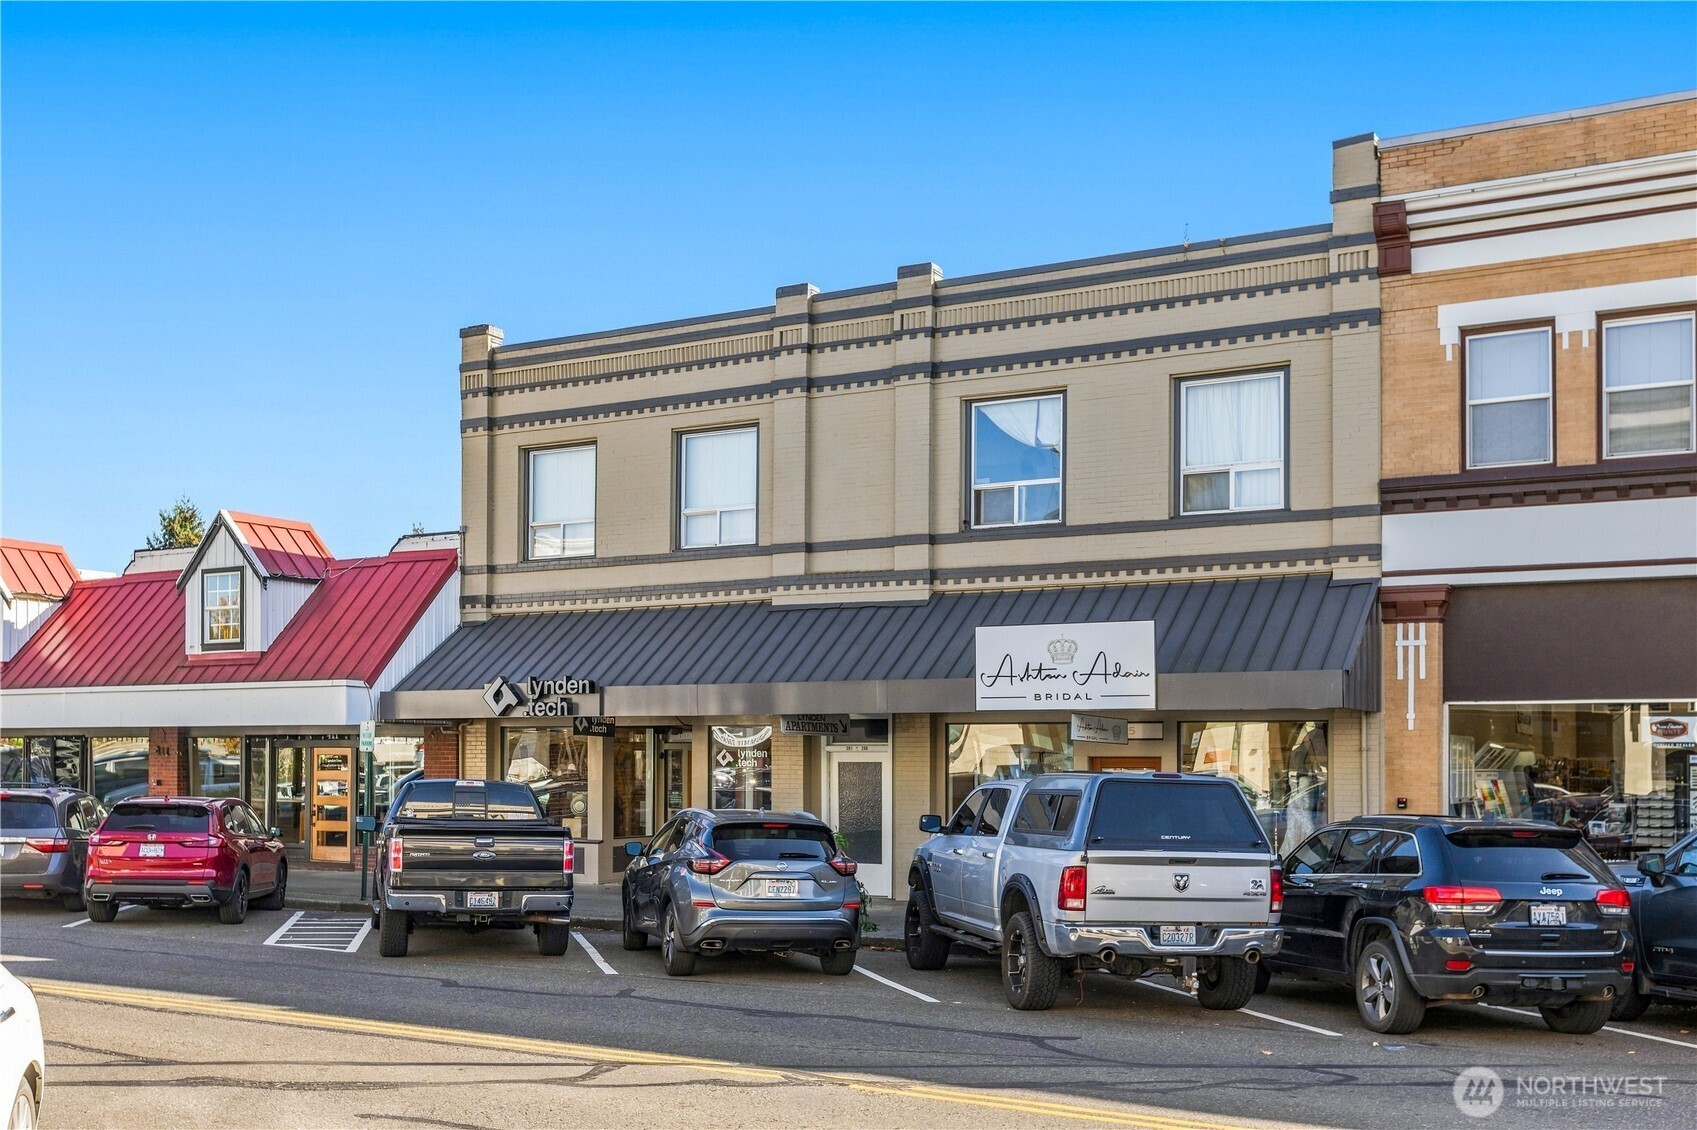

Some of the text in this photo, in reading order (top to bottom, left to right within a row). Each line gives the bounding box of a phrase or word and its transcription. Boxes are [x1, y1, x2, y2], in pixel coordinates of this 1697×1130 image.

[980, 651, 1150, 687] Ashton Adair
[527, 676, 590, 699] lynden
[1034, 693, 1093, 701] BRIDAL
[523, 697, 568, 716] .tech
[785, 721, 839, 733] APARTMENTS
[737, 749, 768, 760] lynden
[1540, 886, 1563, 896] Jeep
